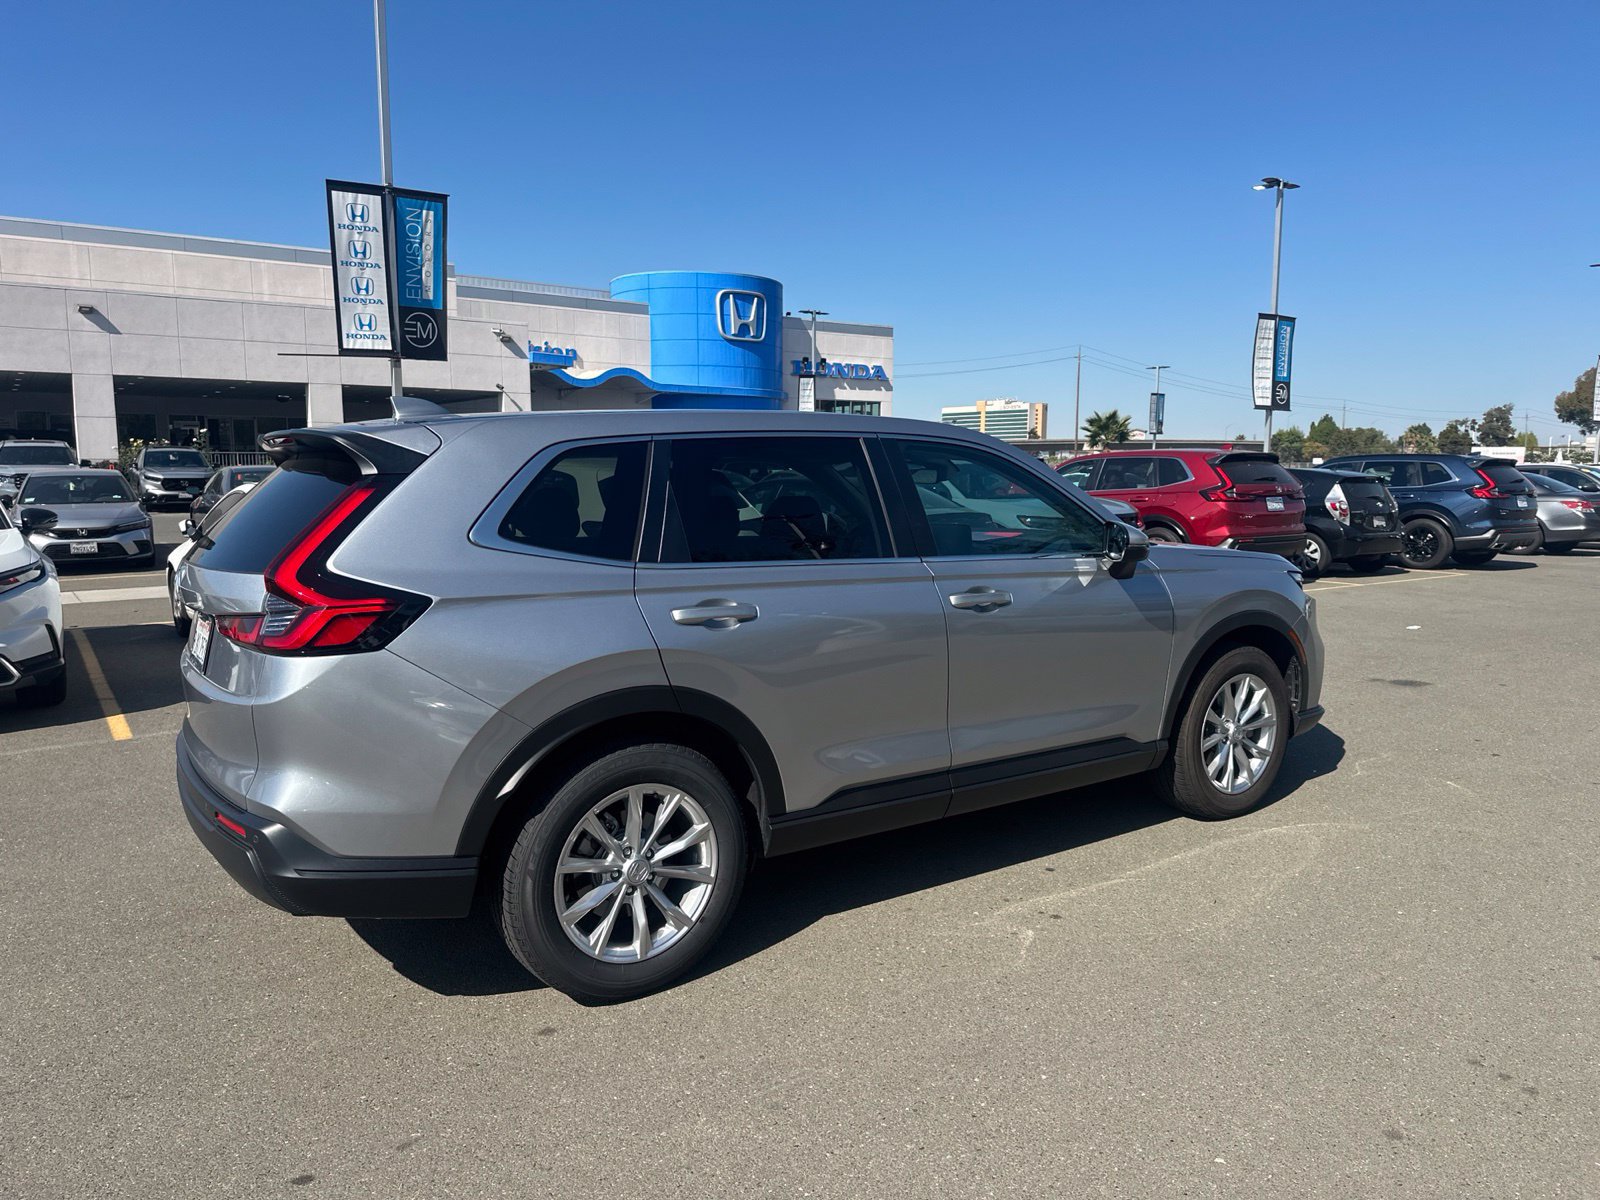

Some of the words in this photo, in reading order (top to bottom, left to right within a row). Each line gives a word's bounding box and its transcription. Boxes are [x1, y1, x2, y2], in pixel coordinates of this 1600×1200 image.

[337, 223, 379, 233] HONDA
[405, 207, 422, 300] ENVISION
[340, 260, 382, 269] HONDA
[342, 296, 384, 305] HONDA
[346, 333, 387, 341] HONDA
[1277, 325, 1287, 377] ENVISION
[791, 360, 889, 380] HONDA
